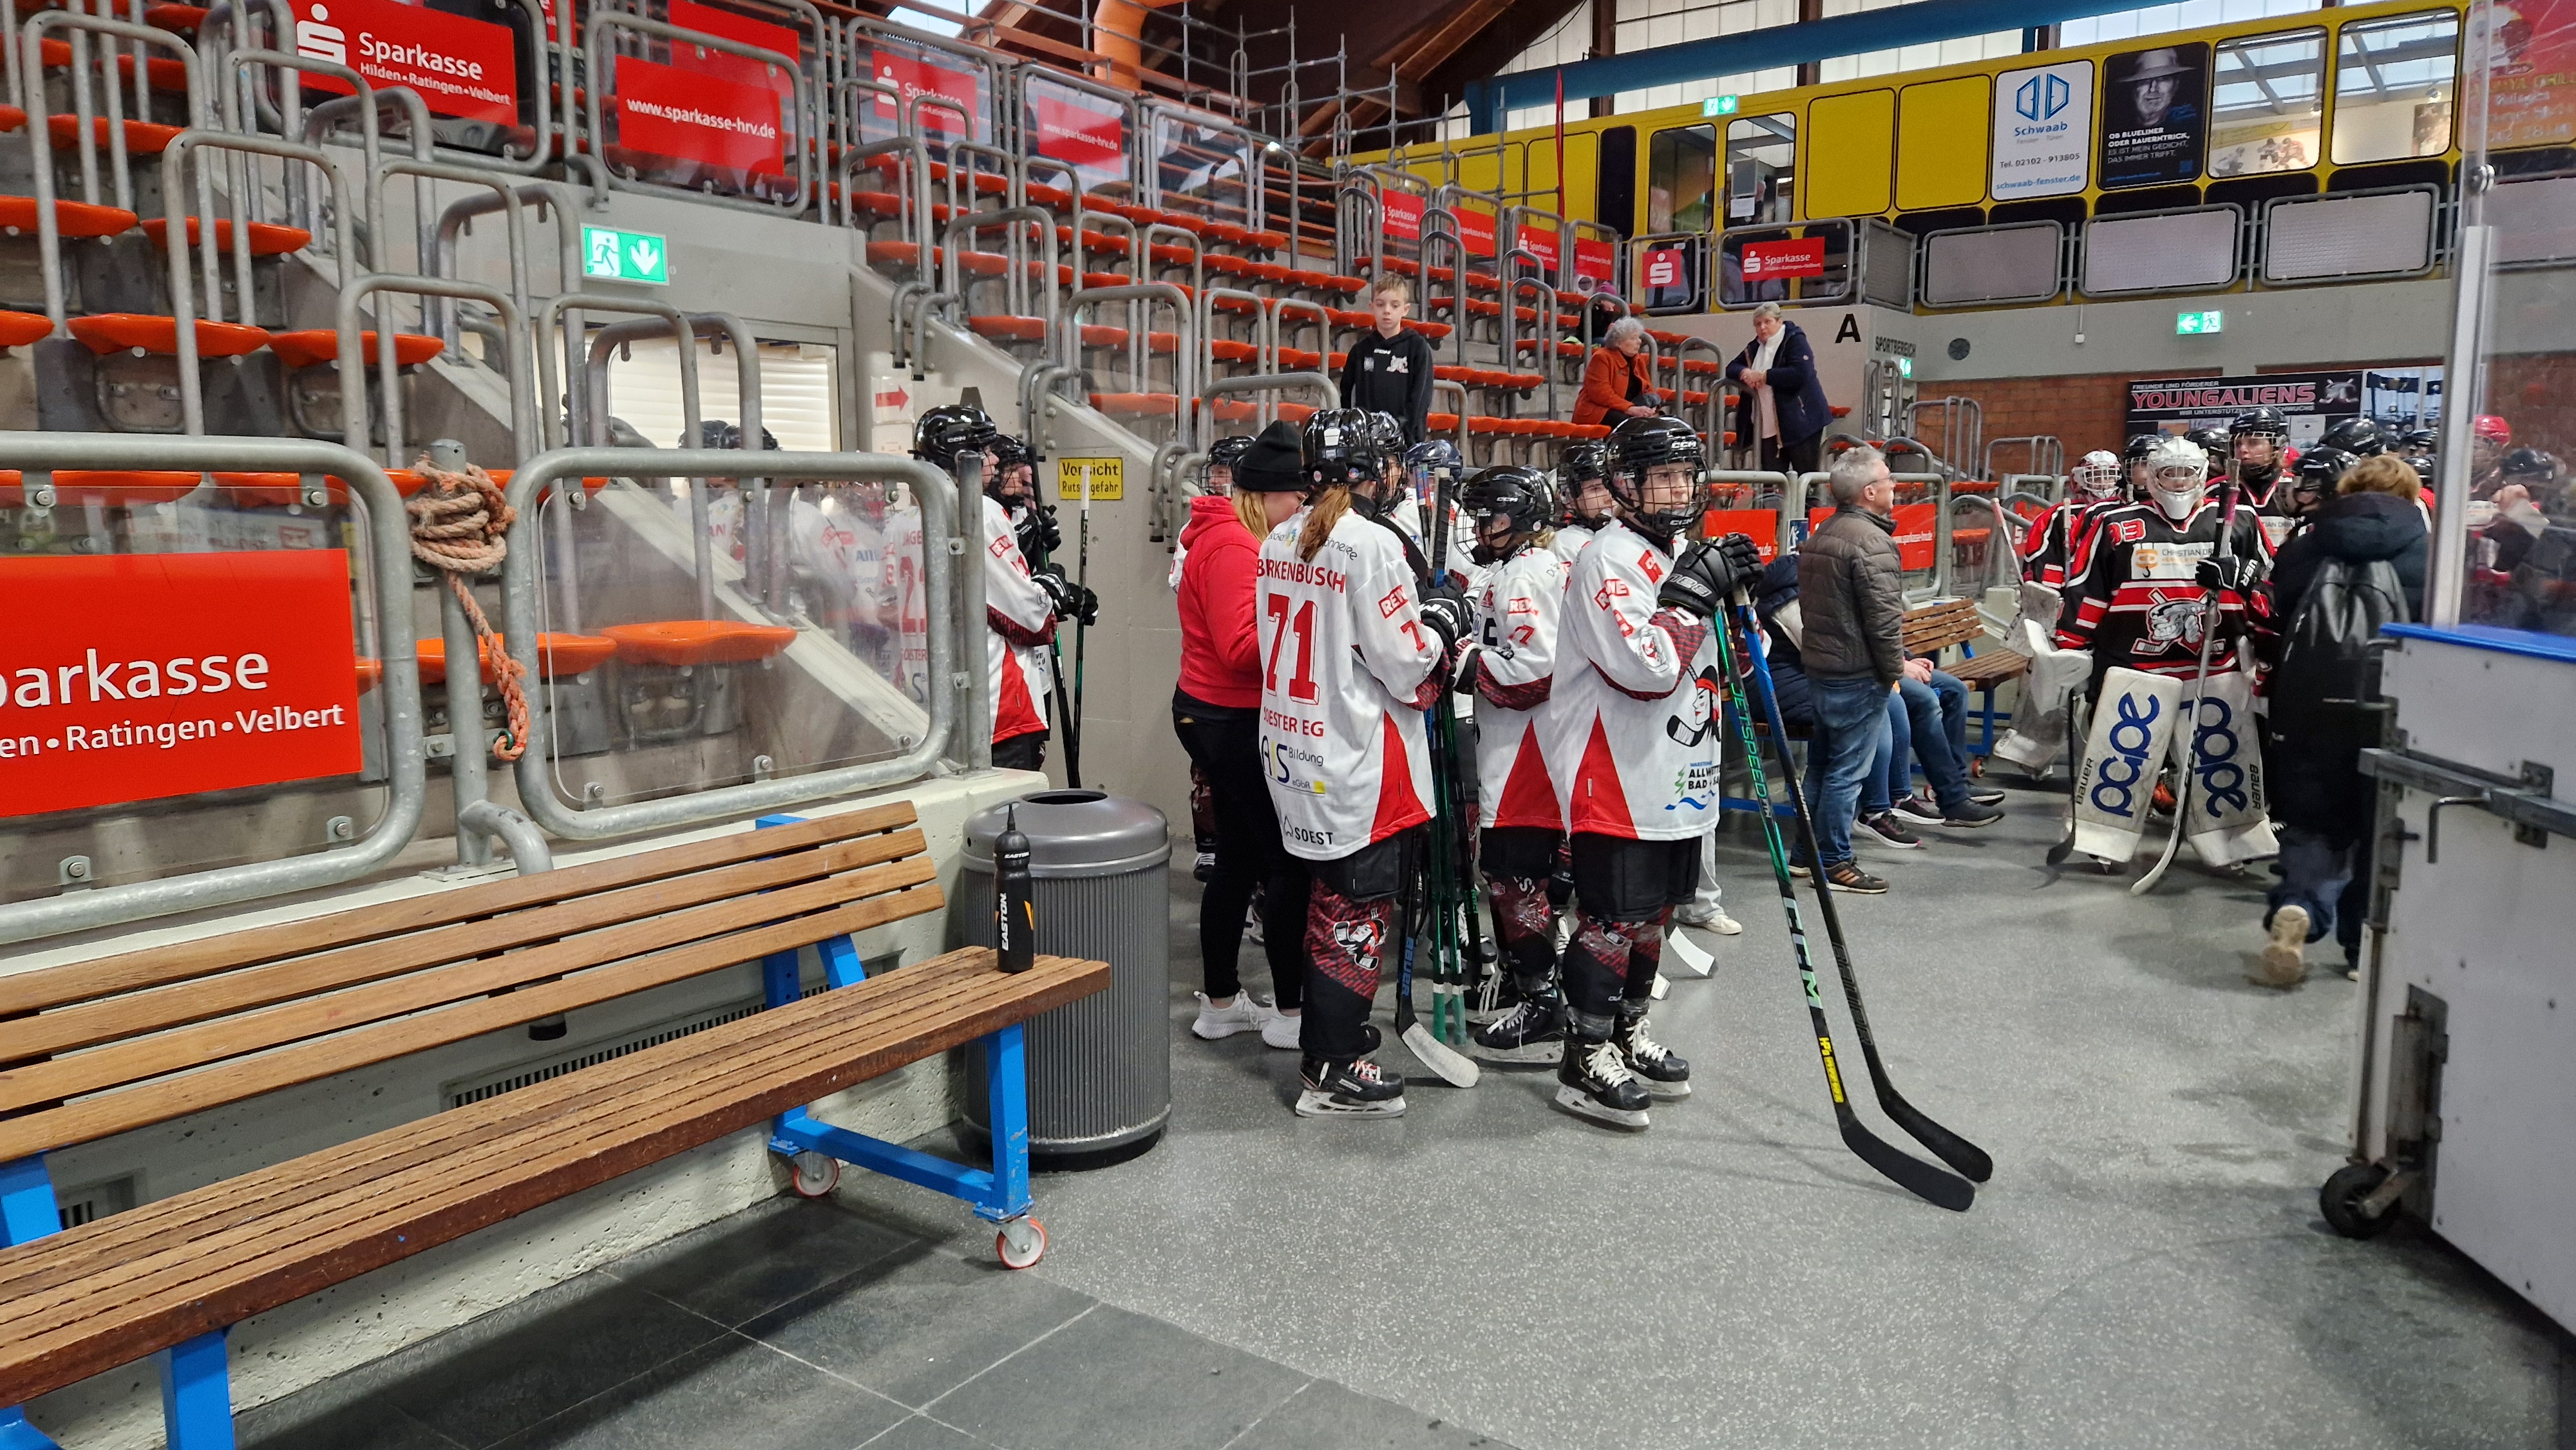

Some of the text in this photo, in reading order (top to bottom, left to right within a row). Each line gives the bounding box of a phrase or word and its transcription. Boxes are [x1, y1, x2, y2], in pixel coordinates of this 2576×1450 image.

[359, 32, 483, 80] Sparkasse
[626, 99, 776, 139] www.sparkasse-hrv.de
[2014, 122, 2068, 137] Schwaab
[1043, 121, 1118, 151] www.sparkasse-hrv.de
[2121, 127, 2164, 138] BLUELINER
[2016, 157, 2041, 167] 02102
[2048, 153, 2081, 162] 913805
[1996, 174, 2081, 190] schwaab-fenster.de
[1387, 205, 1417, 222] Sparkasse
[1765, 254, 1811, 265] Sparkasse
[1835, 313, 1862, 344] A
[1875, 335, 1917, 358] SPORTBEREICH
[2131, 386, 2316, 409] YOUNGALIENS
[2194, 406, 2249, 416] UNTERSTÜTZE
[1671, 440, 1698, 449] CCM
[1063, 462, 1119, 476] Voricht
[1063, 480, 1119, 495] Rutsgefahr
[1266, 593, 1320, 706] 71
[1264, 706, 1324, 737] SOESTER EG
[1730, 683, 1767, 798] JETSPEED
[1289, 746, 1324, 767] Bildung
[1688, 779, 1708, 789] BAD
[1294, 827, 1334, 845] SOEST
[999, 892, 1009, 952] EASTON
[1783, 896, 1824, 1010] CCM
[1401, 936, 1415, 997] BAUER
